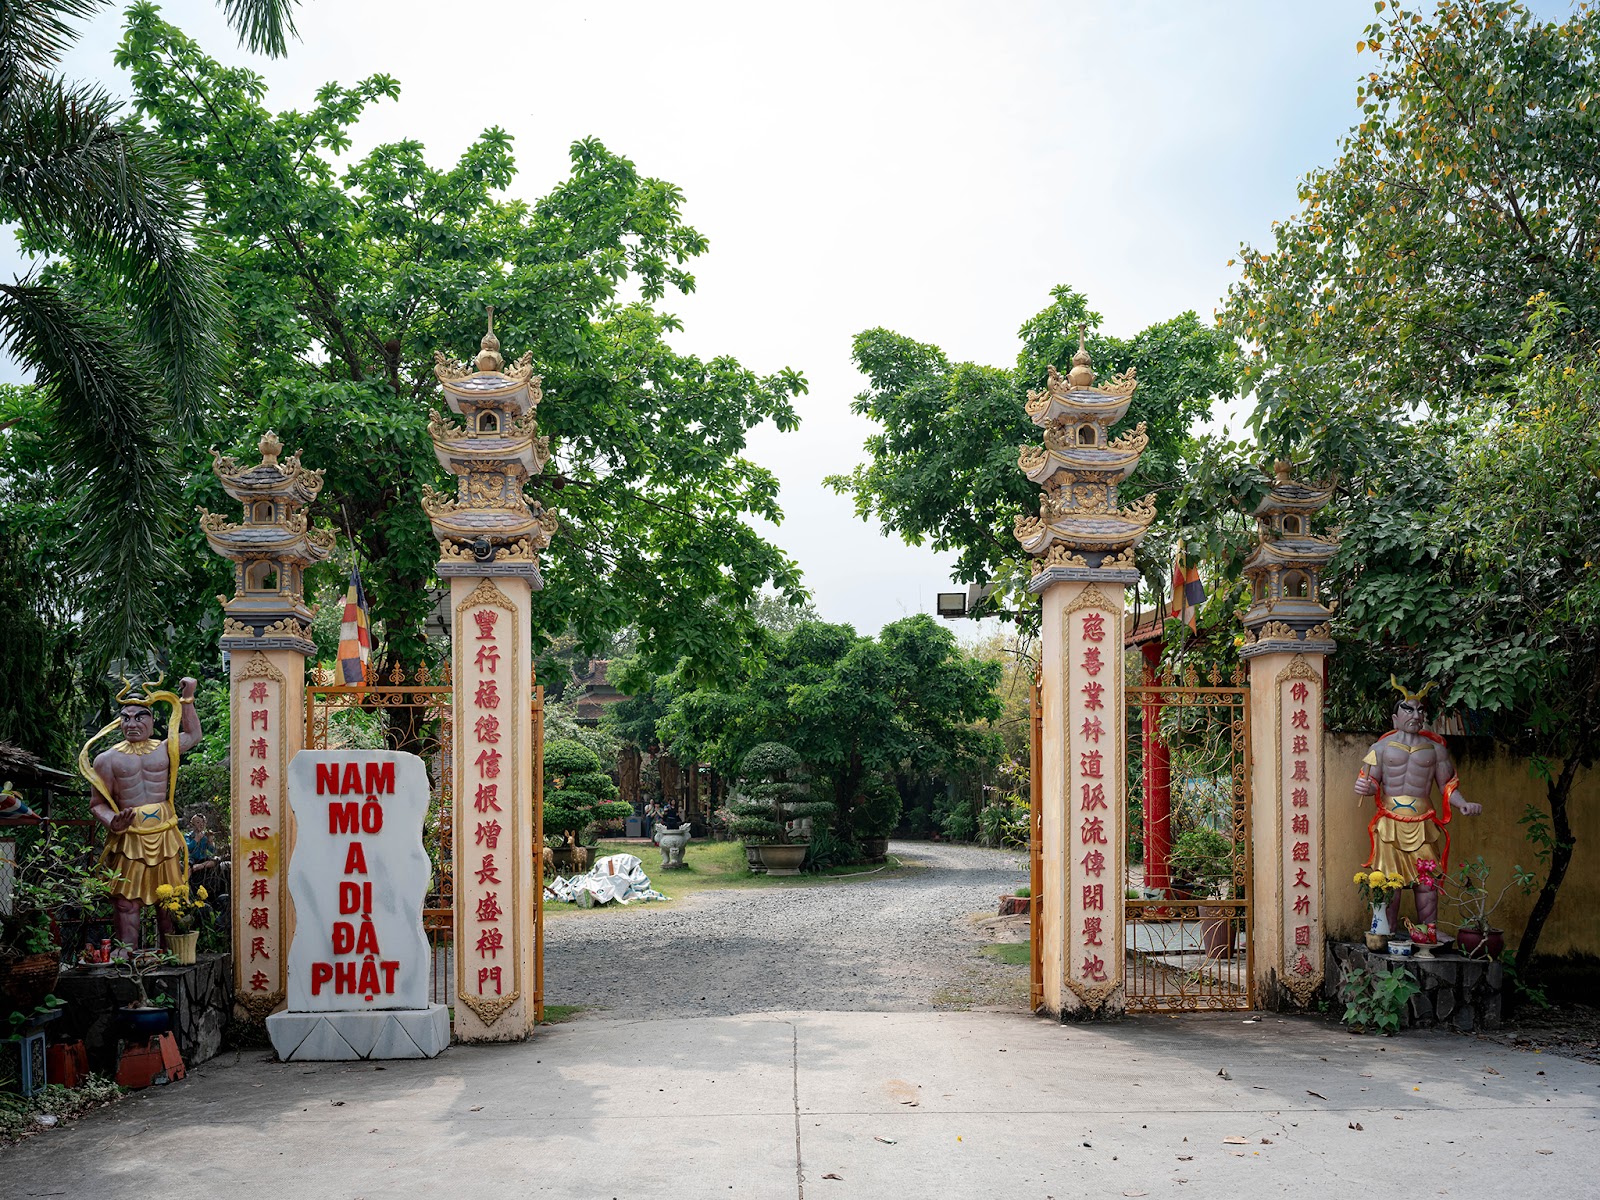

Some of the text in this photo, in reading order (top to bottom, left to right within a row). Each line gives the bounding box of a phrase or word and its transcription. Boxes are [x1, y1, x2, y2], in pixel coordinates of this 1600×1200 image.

[316, 762, 395, 795] NAM
[328, 795, 383, 834] MÔ
[344, 842, 367, 874] A
[339, 881, 372, 915] DI
[332, 913, 380, 955] ĐÀ
[311, 954, 400, 1001] PHẬT
